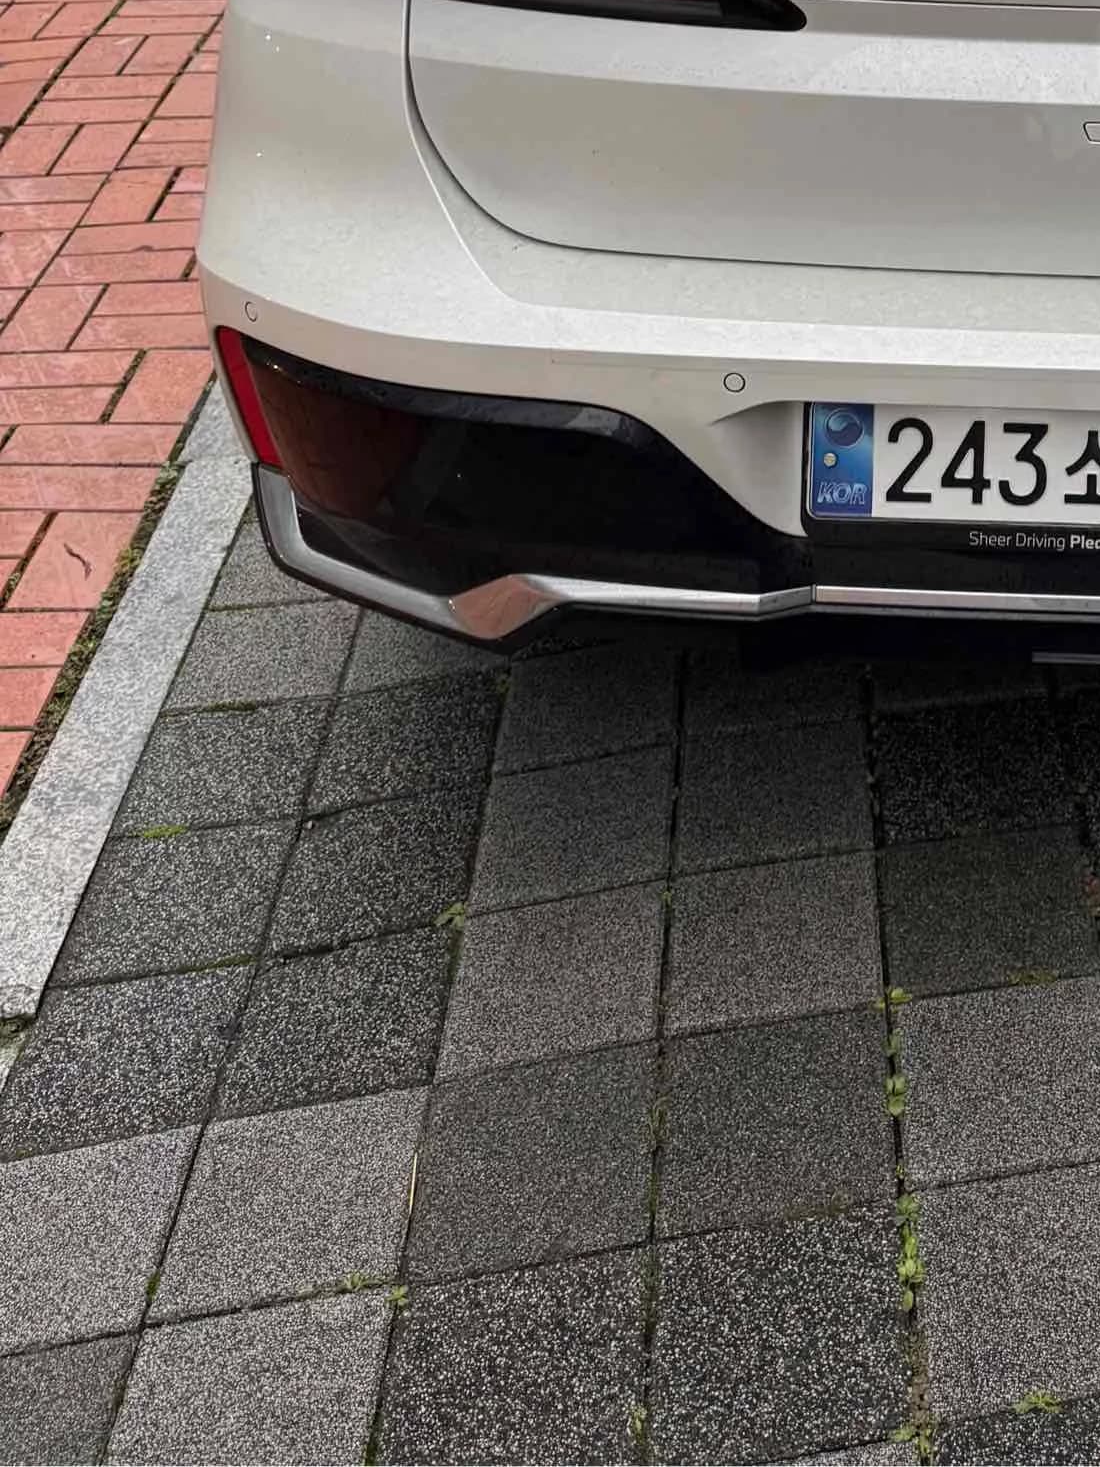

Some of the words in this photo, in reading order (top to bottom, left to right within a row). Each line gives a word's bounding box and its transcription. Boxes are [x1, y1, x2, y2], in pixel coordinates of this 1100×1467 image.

[815, 482, 869, 506] KOR
[968, 531, 1011, 548] Sheer
[1015, 533, 1066, 551] Driving
